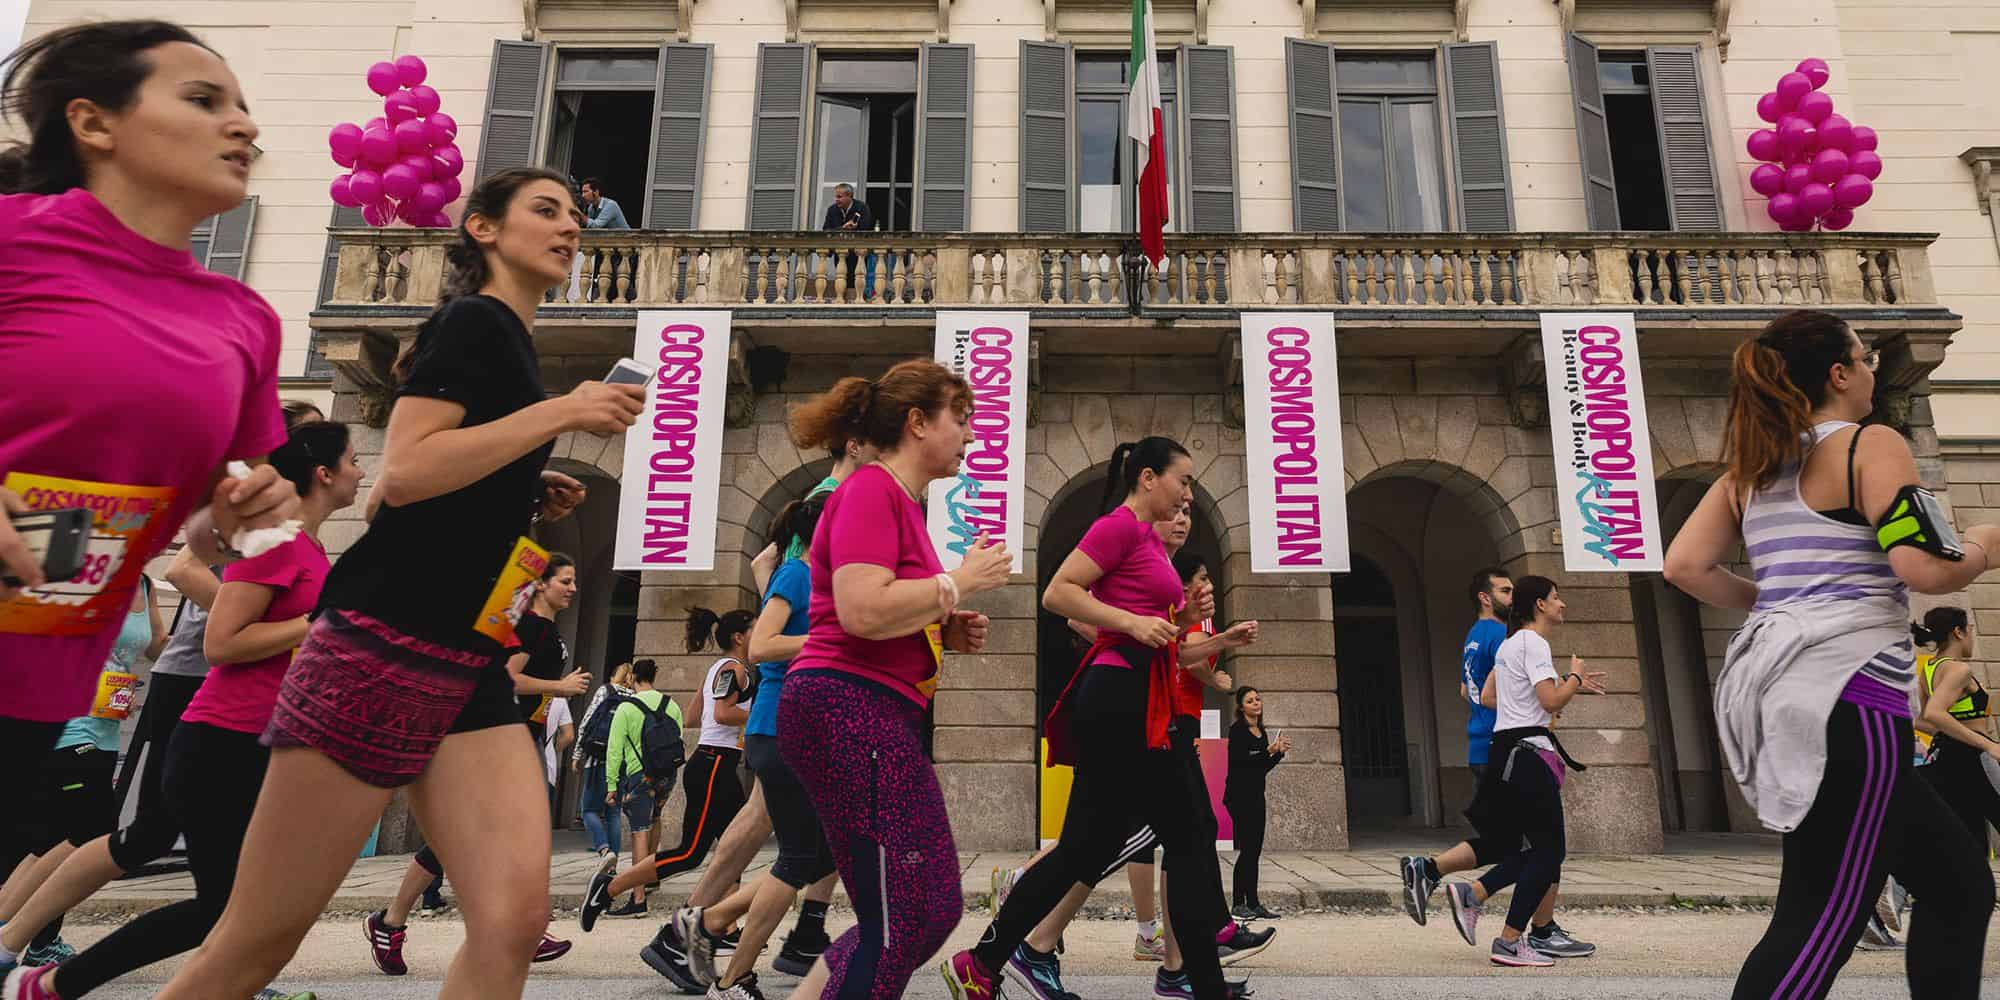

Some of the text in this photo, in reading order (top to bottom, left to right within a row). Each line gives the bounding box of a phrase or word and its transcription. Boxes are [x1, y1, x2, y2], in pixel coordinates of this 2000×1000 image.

[641, 324, 704, 564] COSMOPOLITAN
[1266, 326, 1323, 566] COSMOPOLITAN
[1562, 329, 1589, 472] Beauty & Body
[1577, 325, 1646, 560] COSMOPOLITAN
[1576, 471, 1619, 568] RUN
